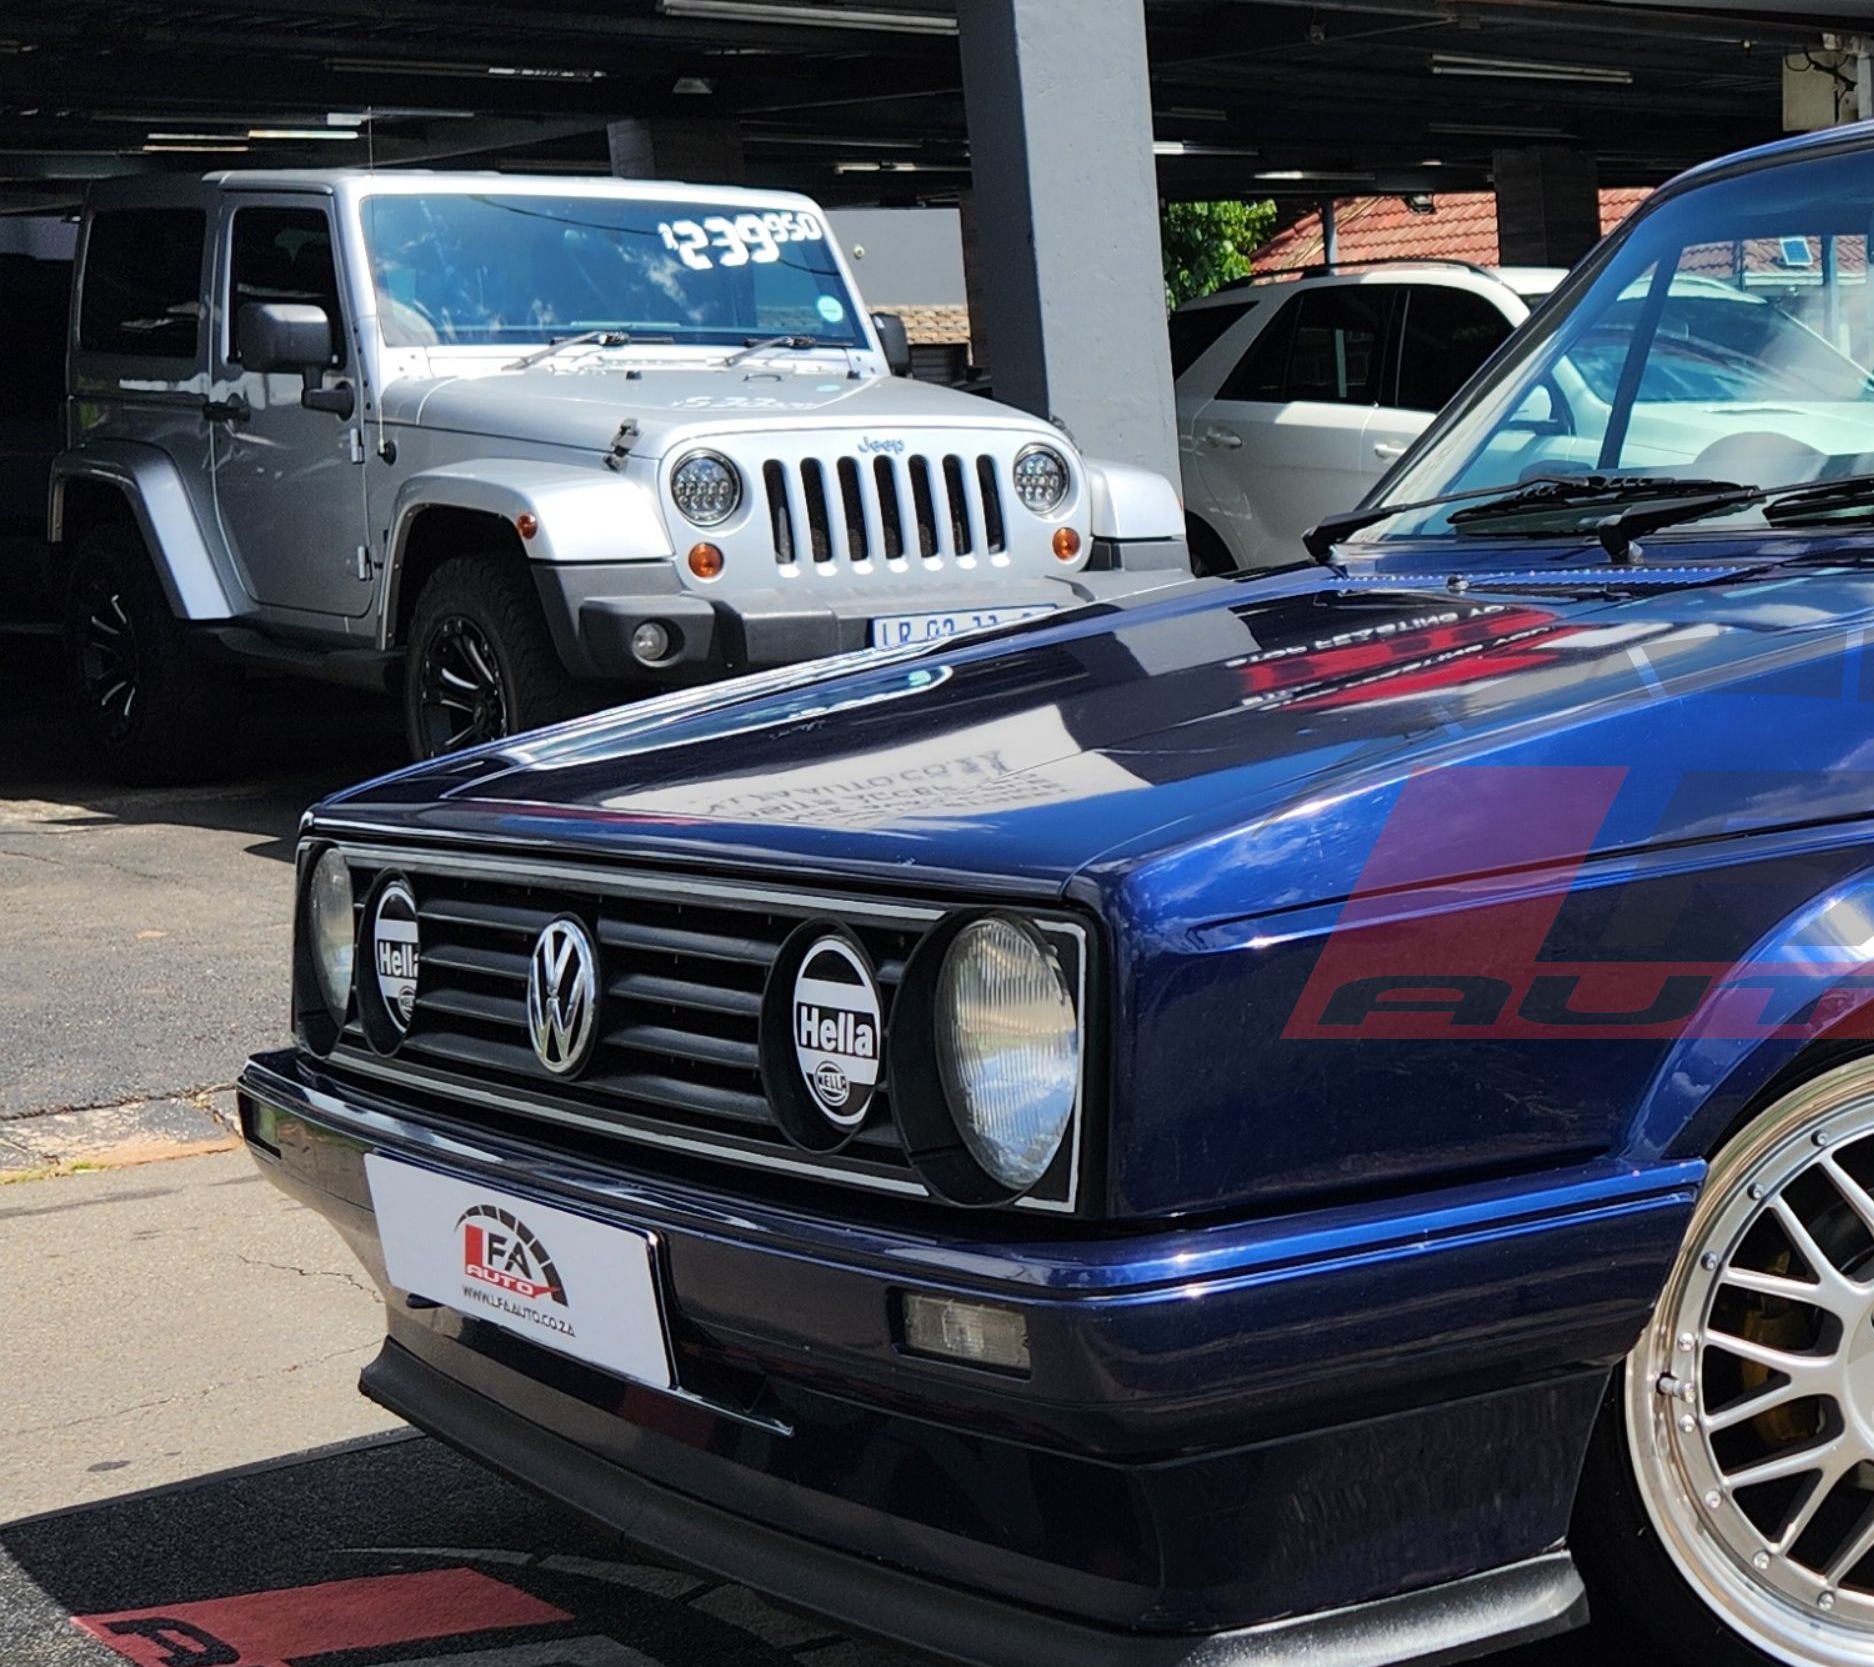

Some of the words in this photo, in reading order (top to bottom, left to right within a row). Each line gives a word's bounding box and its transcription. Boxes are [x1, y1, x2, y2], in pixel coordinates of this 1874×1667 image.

[857, 435, 906, 455] Jeep
[800, 1004, 874, 1058] Hella
[466, 1263, 534, 1295] AUTO
